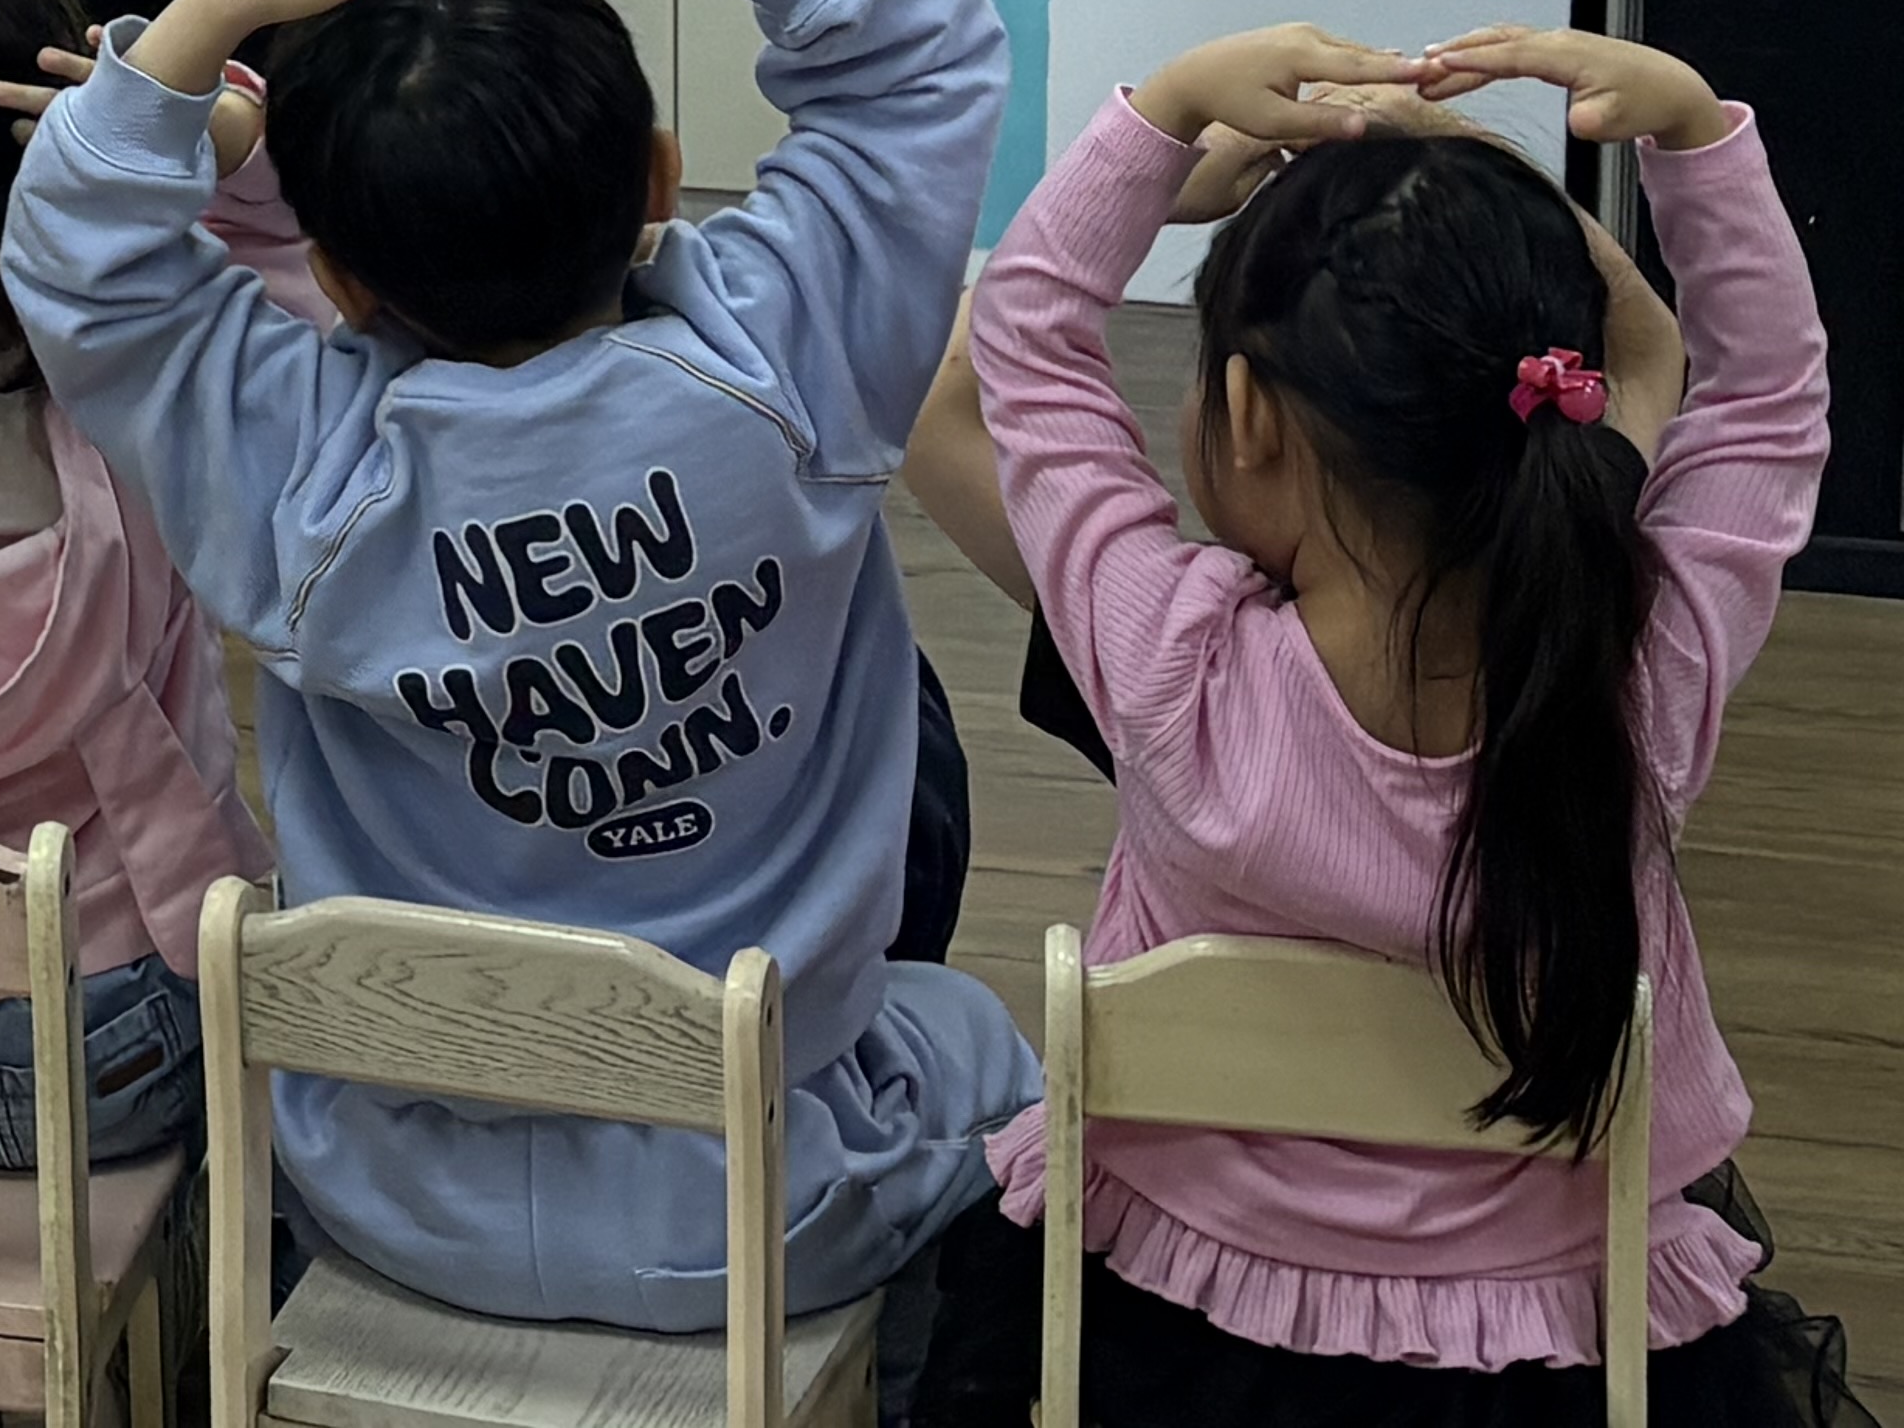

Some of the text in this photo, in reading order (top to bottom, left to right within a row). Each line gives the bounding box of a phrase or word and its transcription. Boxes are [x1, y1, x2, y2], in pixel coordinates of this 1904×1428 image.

[432, 466, 695, 642] NEW
[395, 555, 785, 747] HAVEN
[466, 670, 793, 831] CONN.
[601, 813, 699, 850] YALE
